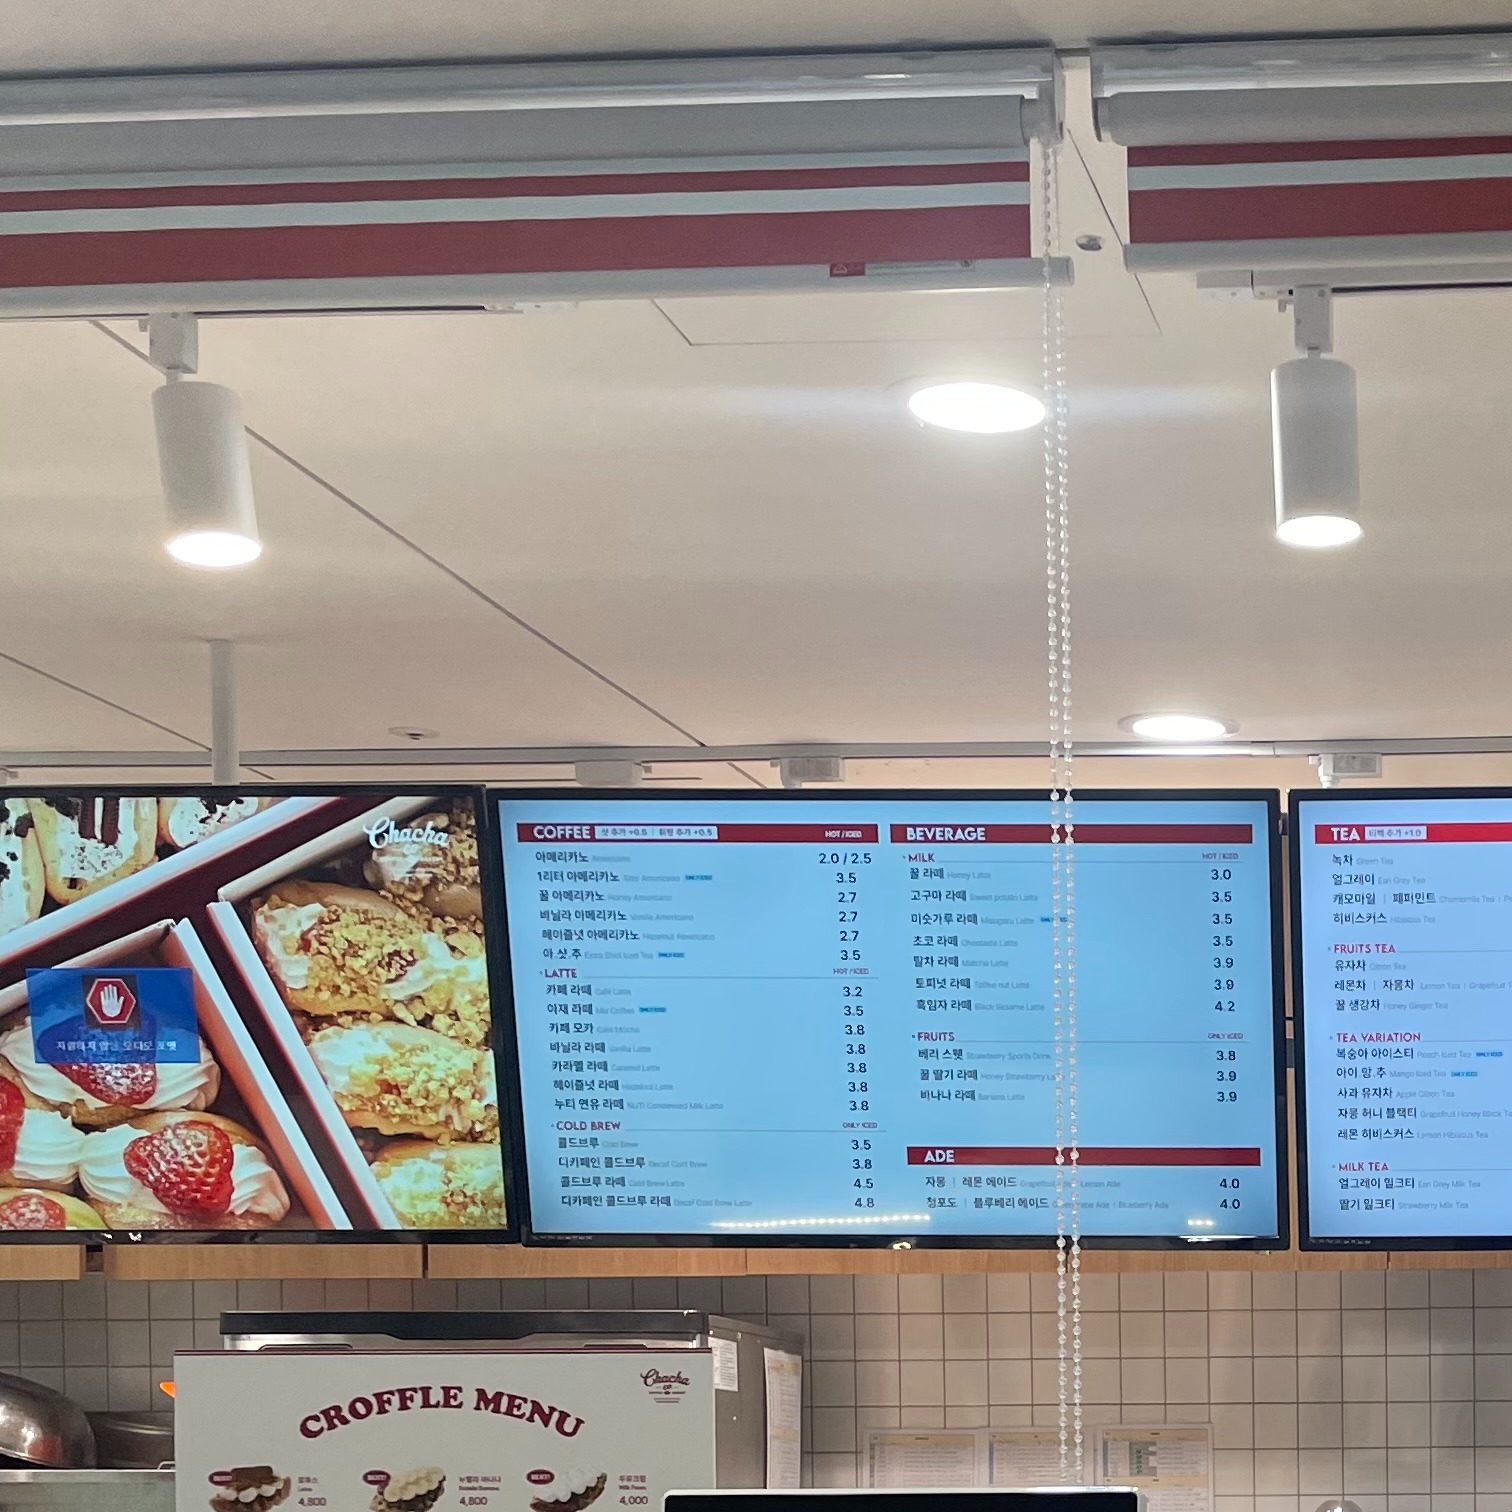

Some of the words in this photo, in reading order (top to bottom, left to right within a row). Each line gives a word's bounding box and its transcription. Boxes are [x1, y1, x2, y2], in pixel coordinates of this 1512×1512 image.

[363, 817, 449, 847] Chacha
[533, 826, 591, 839] COFFEE
[907, 828, 985, 841] BEVERAGE
[1331, 828, 1360, 841] TEA
[819, 853, 839, 864] 2.0
[851, 853, 871, 864] 2.5
[909, 853, 934, 862] MILK
[538, 871, 564, 882] 1리터
[837, 873, 856, 883] 3.5
[838, 892, 856, 903] 2.7
[1212, 891, 1231, 902] 3.5
[1213, 914, 1232, 924] 3.5
[1334, 944, 1371, 954] FRUITS
[1375, 944, 1396, 953] TEA
[545, 968, 577, 978] LATTE
[844, 987, 862, 997] 3.2
[918, 1032, 954, 1041] FRUITS
[1337, 1033, 1357, 1042] TEA
[1361, 1033, 1420, 1042] VARIATION
[1217, 1071, 1236, 1081] 3.9
[557, 1121, 587, 1130] COLD
[591, 1121, 620, 1130] BREW
[852, 1140, 871, 1150] 3.5
[924, 1150, 954, 1162] ADE
[1339, 1162, 1364, 1171] MILK
[1369, 1162, 1388, 1171] TEA
[854, 1178, 873, 1188] 4.5
[1220, 1179, 1239, 1188] 4.0
[640, 1368, 691, 1388] Chacha
[299, 1386, 464, 1438] CROFFLE
[473, 1388, 585, 1437] MENU
[619, 1496, 648, 1506] 4,000
